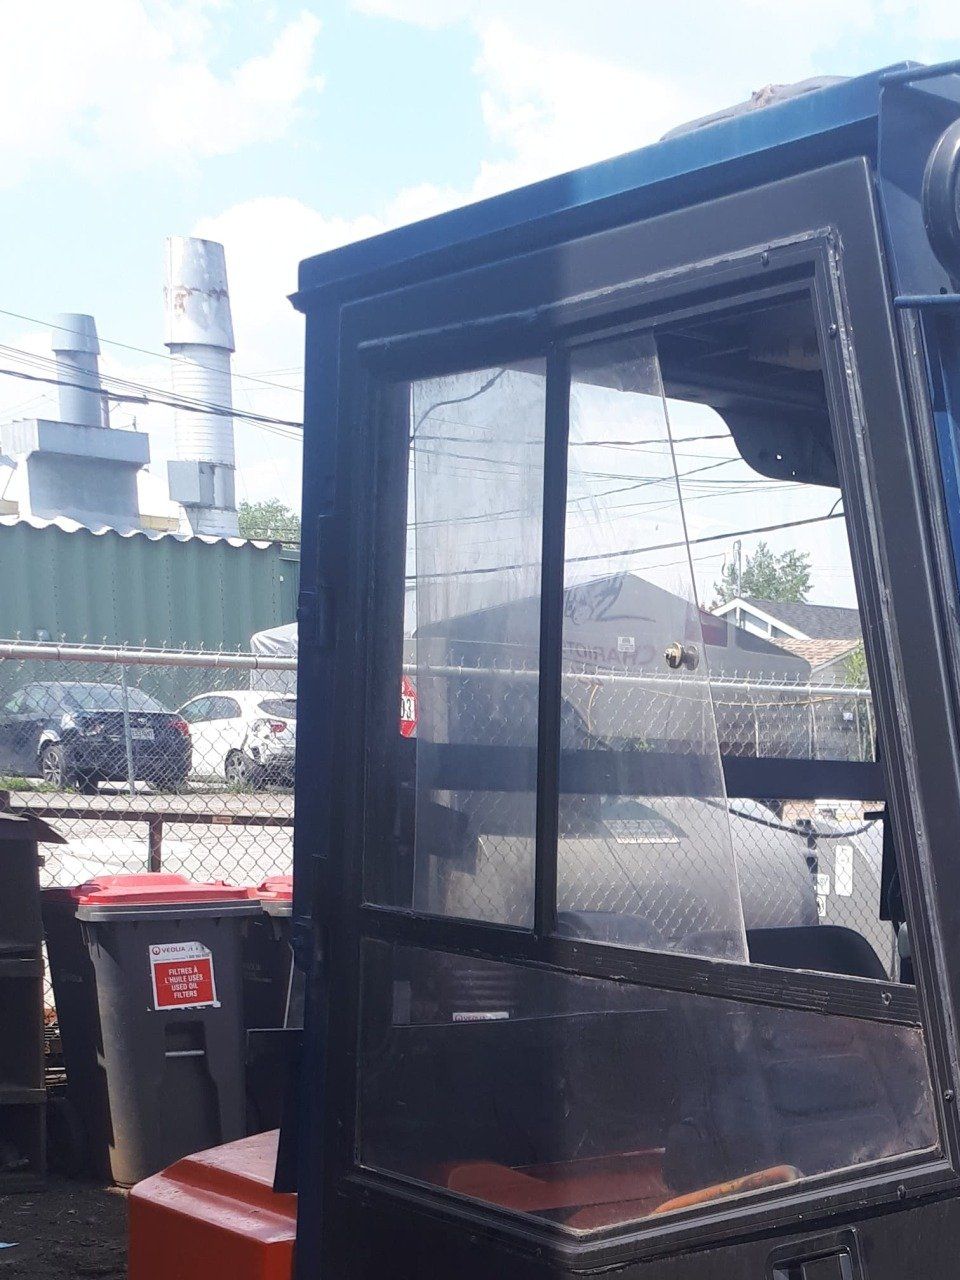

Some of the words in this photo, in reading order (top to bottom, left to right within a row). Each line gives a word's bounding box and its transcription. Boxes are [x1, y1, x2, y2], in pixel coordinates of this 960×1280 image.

[161, 946, 186, 954] VEOLIA
[168, 967, 193, 975] FILTRES
[171, 983, 187, 991] USED
[188, 982, 198, 990] OIL
[174, 990, 197, 998] FILTERS
